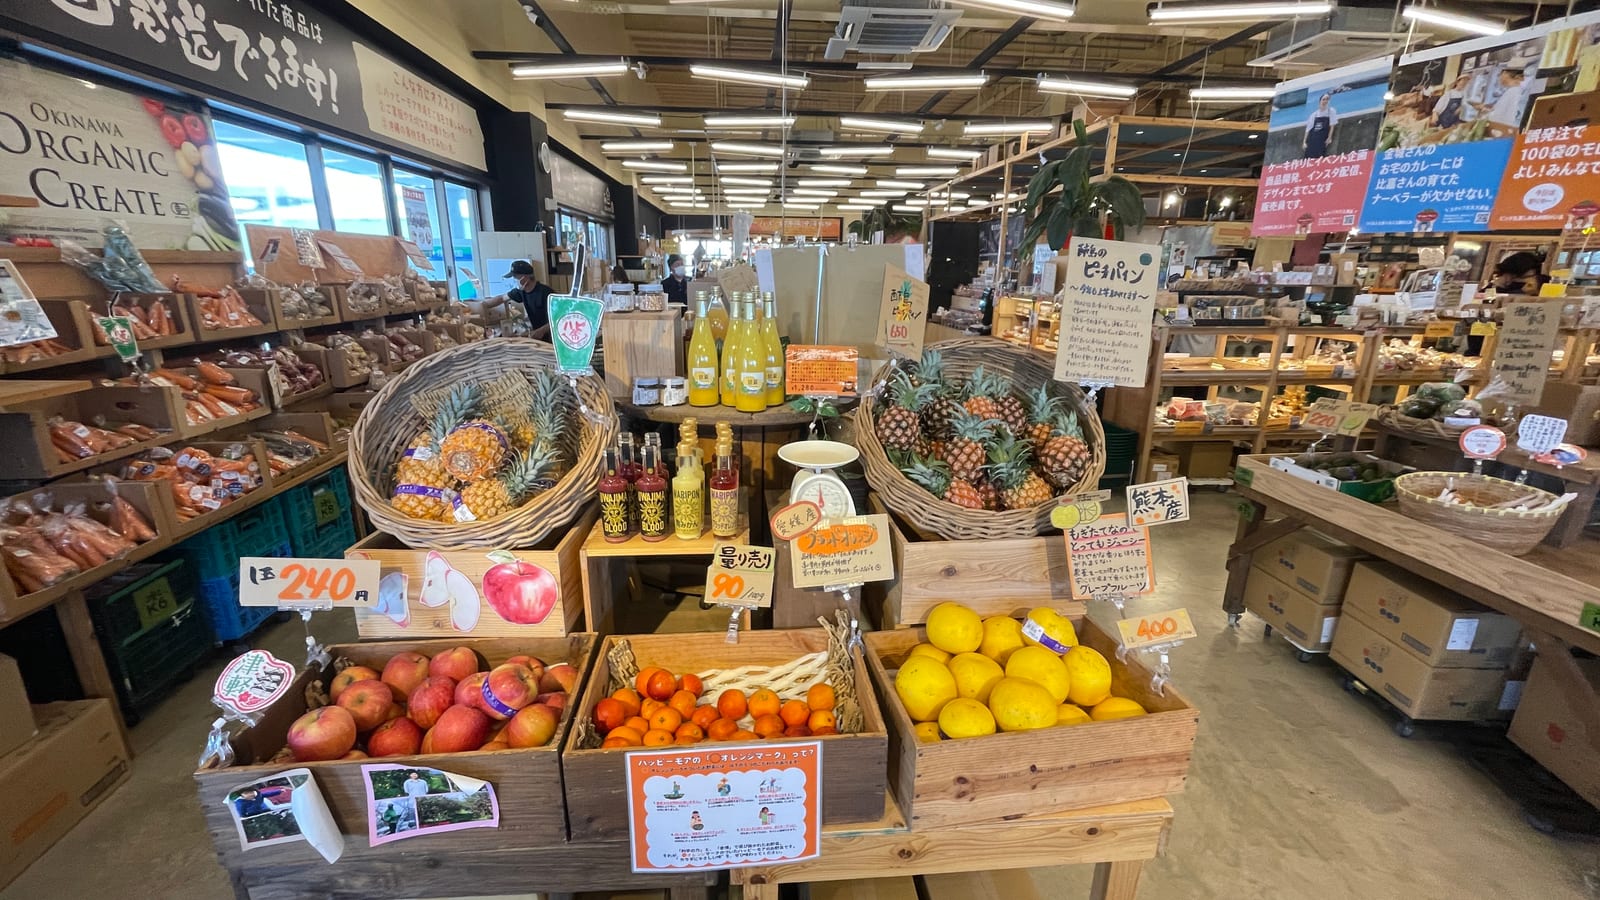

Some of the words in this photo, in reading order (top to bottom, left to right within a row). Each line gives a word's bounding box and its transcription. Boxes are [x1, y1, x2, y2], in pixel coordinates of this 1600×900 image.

[30, 102, 124, 138] OKINAWA
[0, 111, 169, 177] ORGANIC
[1525, 125, 1588, 144] 誤発注で
[1268, 149, 1369, 172] ケーキ作りにイベント企画
[1383, 145, 1437, 160] 金城さんの
[1379, 156, 1465, 175] お宅のカレーには
[1263, 182, 1334, 199] デザインまでこなす
[1375, 173, 1460, 190] 比嘉さんの育てた
[29, 168, 166, 217] CREATE
[1084, 260, 1144, 284] ピーチパイン
[890, 324, 908, 339] 650
[1308, 411, 1336, 427] 220
[1131, 487, 1184, 520] 熊本産
[604, 521, 628, 533] BLOOD
[642, 520, 665, 532] BLOOD
[776, 507, 817, 536] 愛媛産
[1069, 524, 1139, 541] もぎたてなの
[1070, 537, 1146, 552] とってもジューシー
[719, 546, 772, 569] 量り売り
[278, 563, 356, 602] 240
[355, 590, 369, 601] 円
[712, 573, 745, 599] 90
[1080, 581, 1147, 595] グレープフルーツ
[1137, 617, 1178, 640] 400
